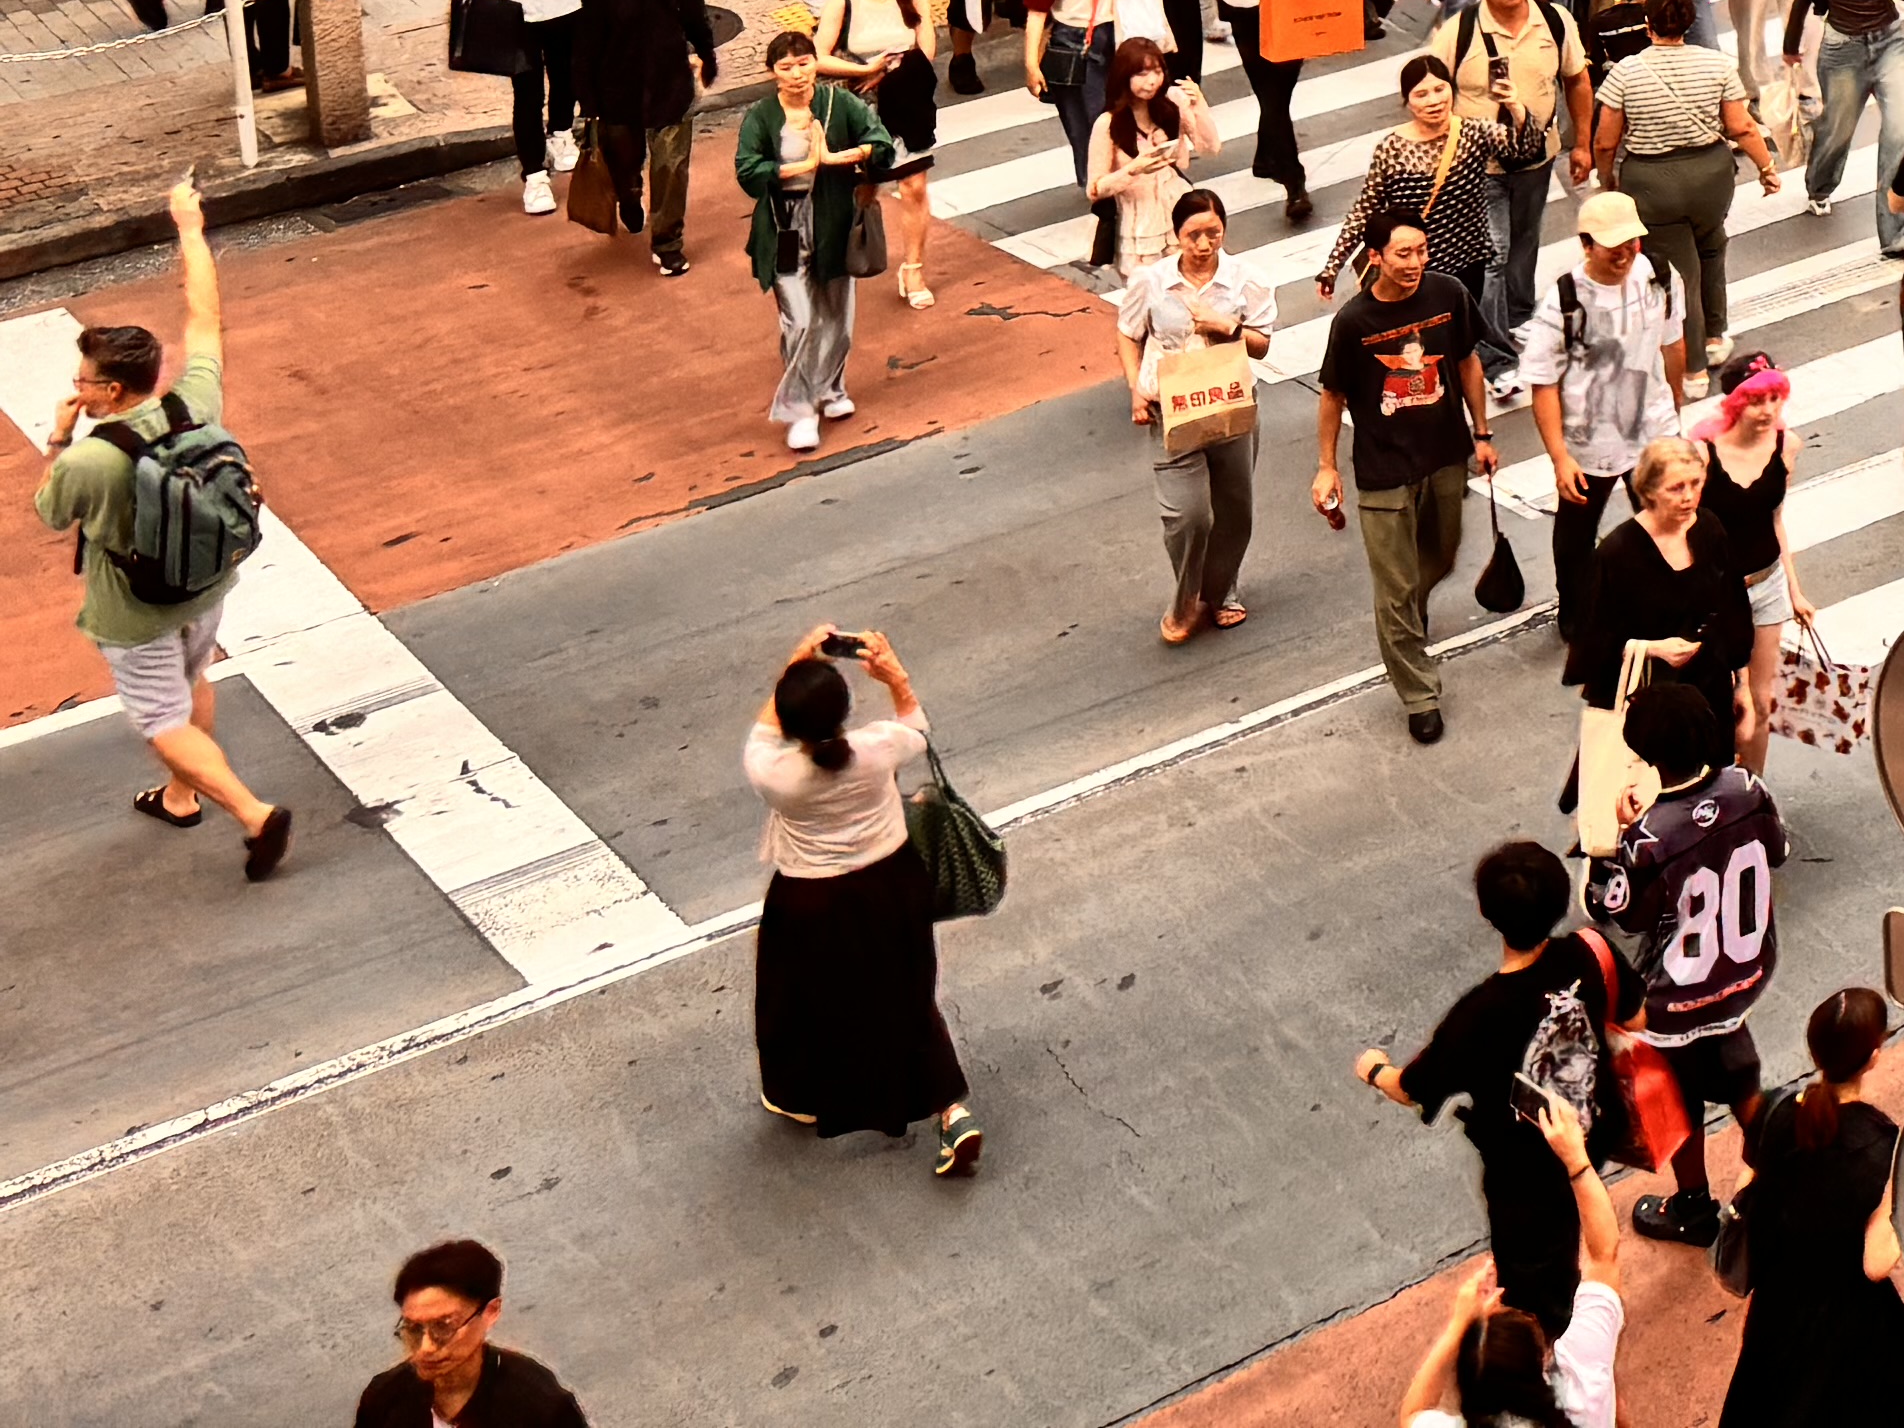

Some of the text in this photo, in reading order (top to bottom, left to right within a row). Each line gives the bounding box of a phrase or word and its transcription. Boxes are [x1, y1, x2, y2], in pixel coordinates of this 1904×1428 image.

[1172, 381, 1244, 413] 無印良品
[1663, 839, 1770, 986] 80
